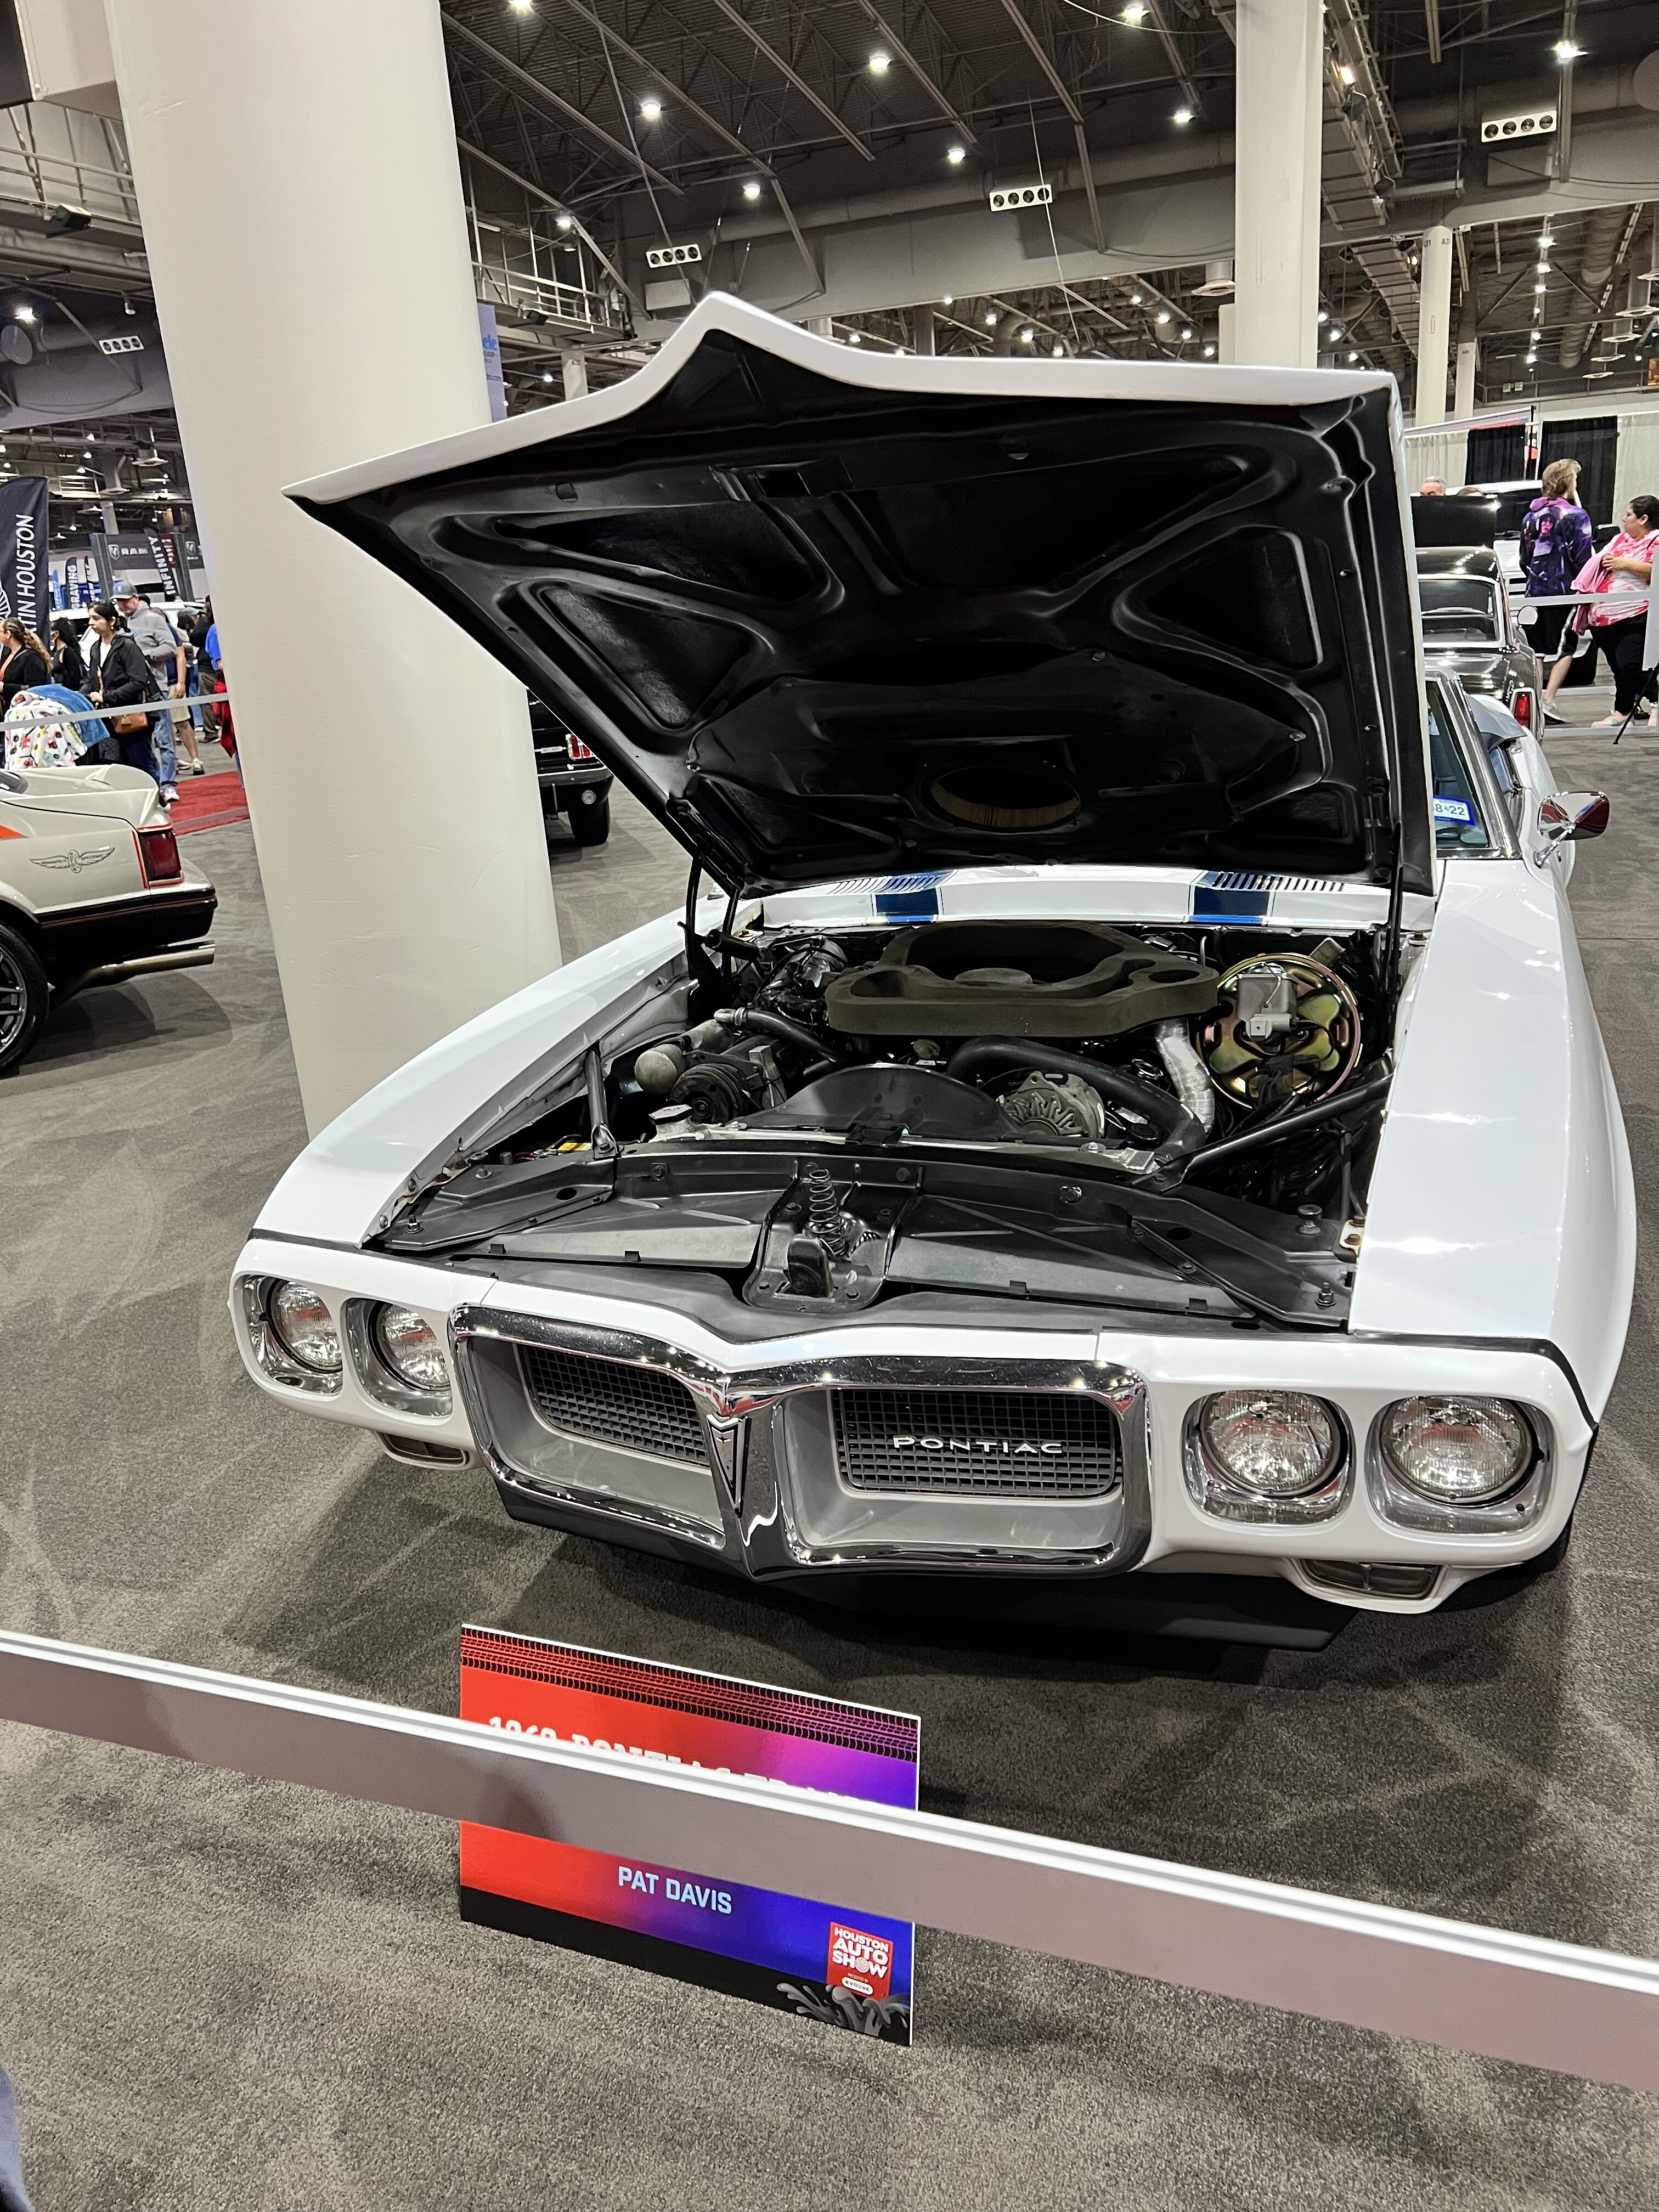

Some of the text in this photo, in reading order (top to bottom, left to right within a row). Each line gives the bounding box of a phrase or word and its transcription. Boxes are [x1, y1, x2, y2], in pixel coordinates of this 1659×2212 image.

[15, 514, 37, 631] TIN HOUSTON
[893, 1436, 1062, 1453] PONTIAC
[618, 1865, 732, 1915] PAT DAVIS
[832, 1937, 888, 1965] AUTO
[834, 1927, 889, 1953] HOUSTON
[832, 1950, 888, 1978] SHOW
[845, 1980, 871, 1991] EVOLVE
